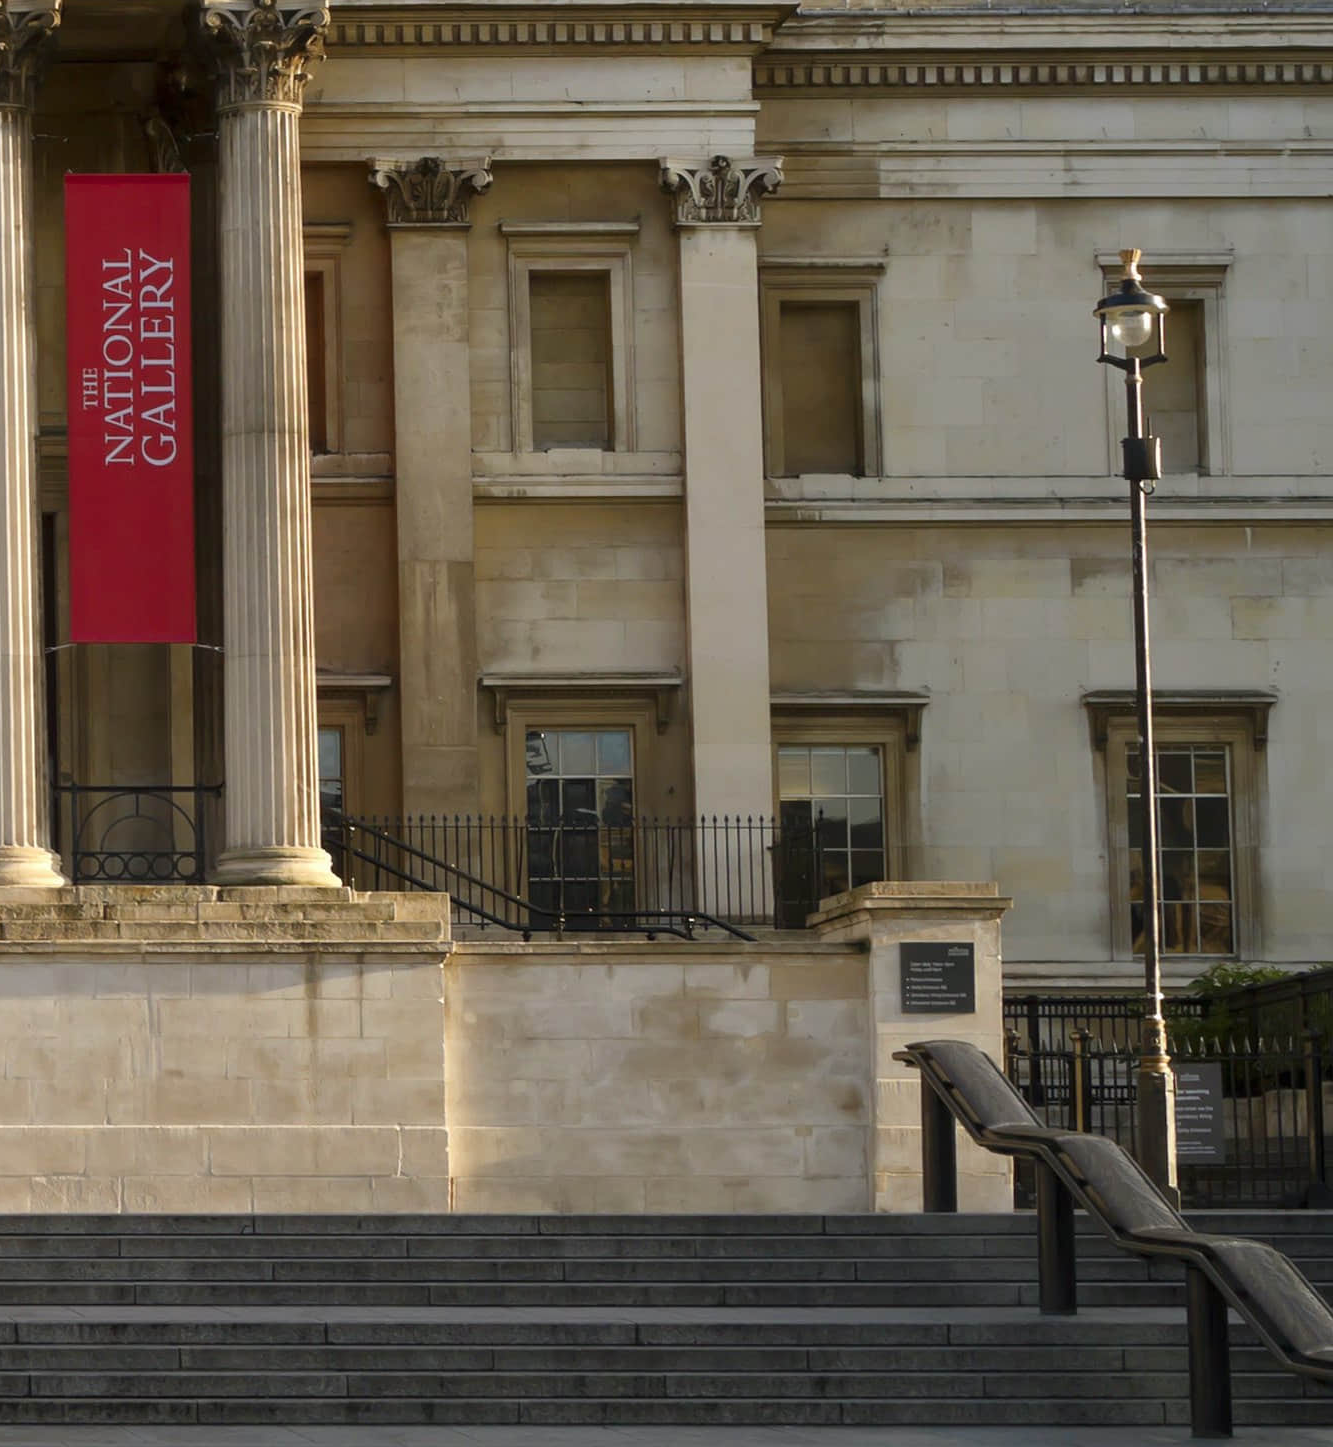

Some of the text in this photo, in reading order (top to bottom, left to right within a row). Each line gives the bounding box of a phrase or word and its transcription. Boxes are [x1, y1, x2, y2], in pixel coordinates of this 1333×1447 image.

[82, 367, 99, 410] THE
[102, 247, 135, 466] NATIONAL
[139, 247, 177, 466] GALLERY
